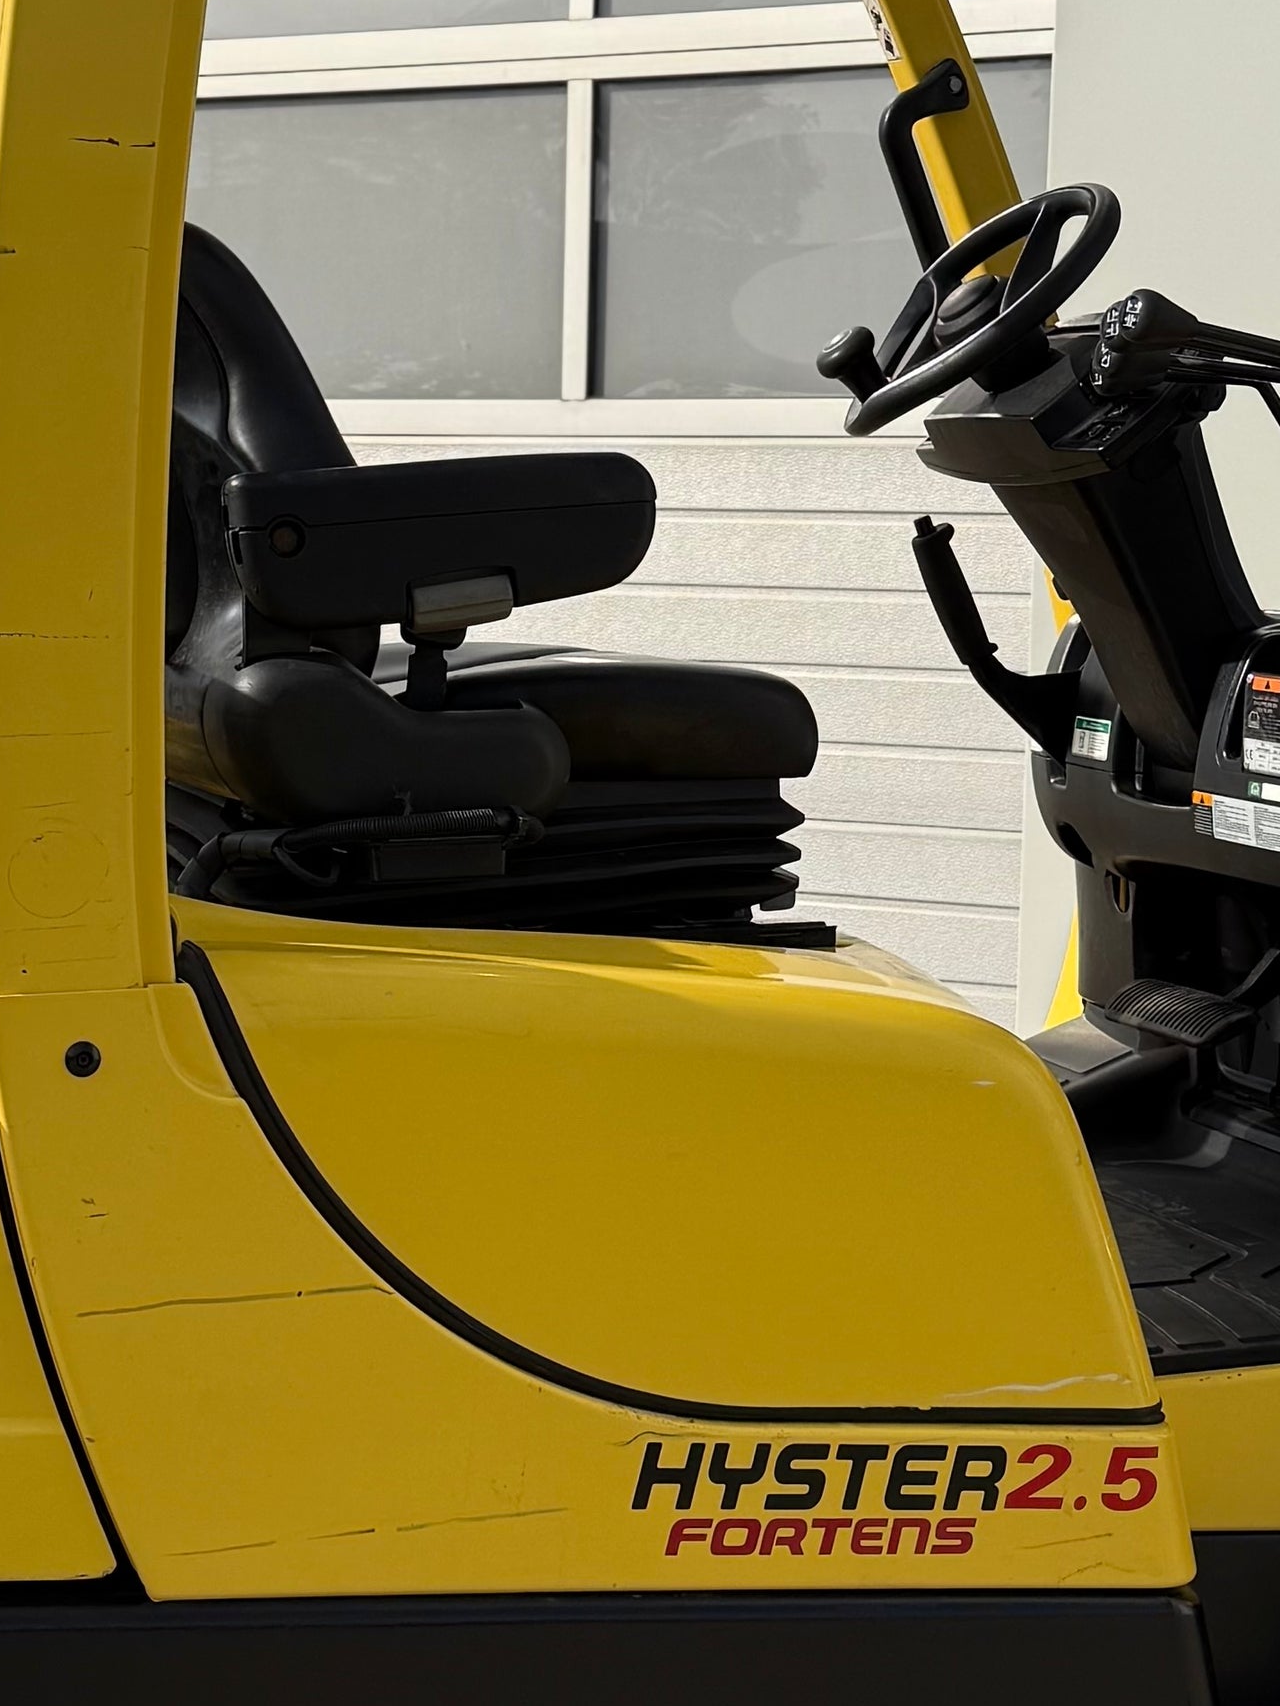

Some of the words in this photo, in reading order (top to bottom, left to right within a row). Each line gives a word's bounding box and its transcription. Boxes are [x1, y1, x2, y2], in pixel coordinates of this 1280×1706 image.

[631, 1441, 1009, 1512] HYSTER
[1004, 1443, 1160, 1513] 2.5
[664, 1517, 978, 1557] FORTENS
